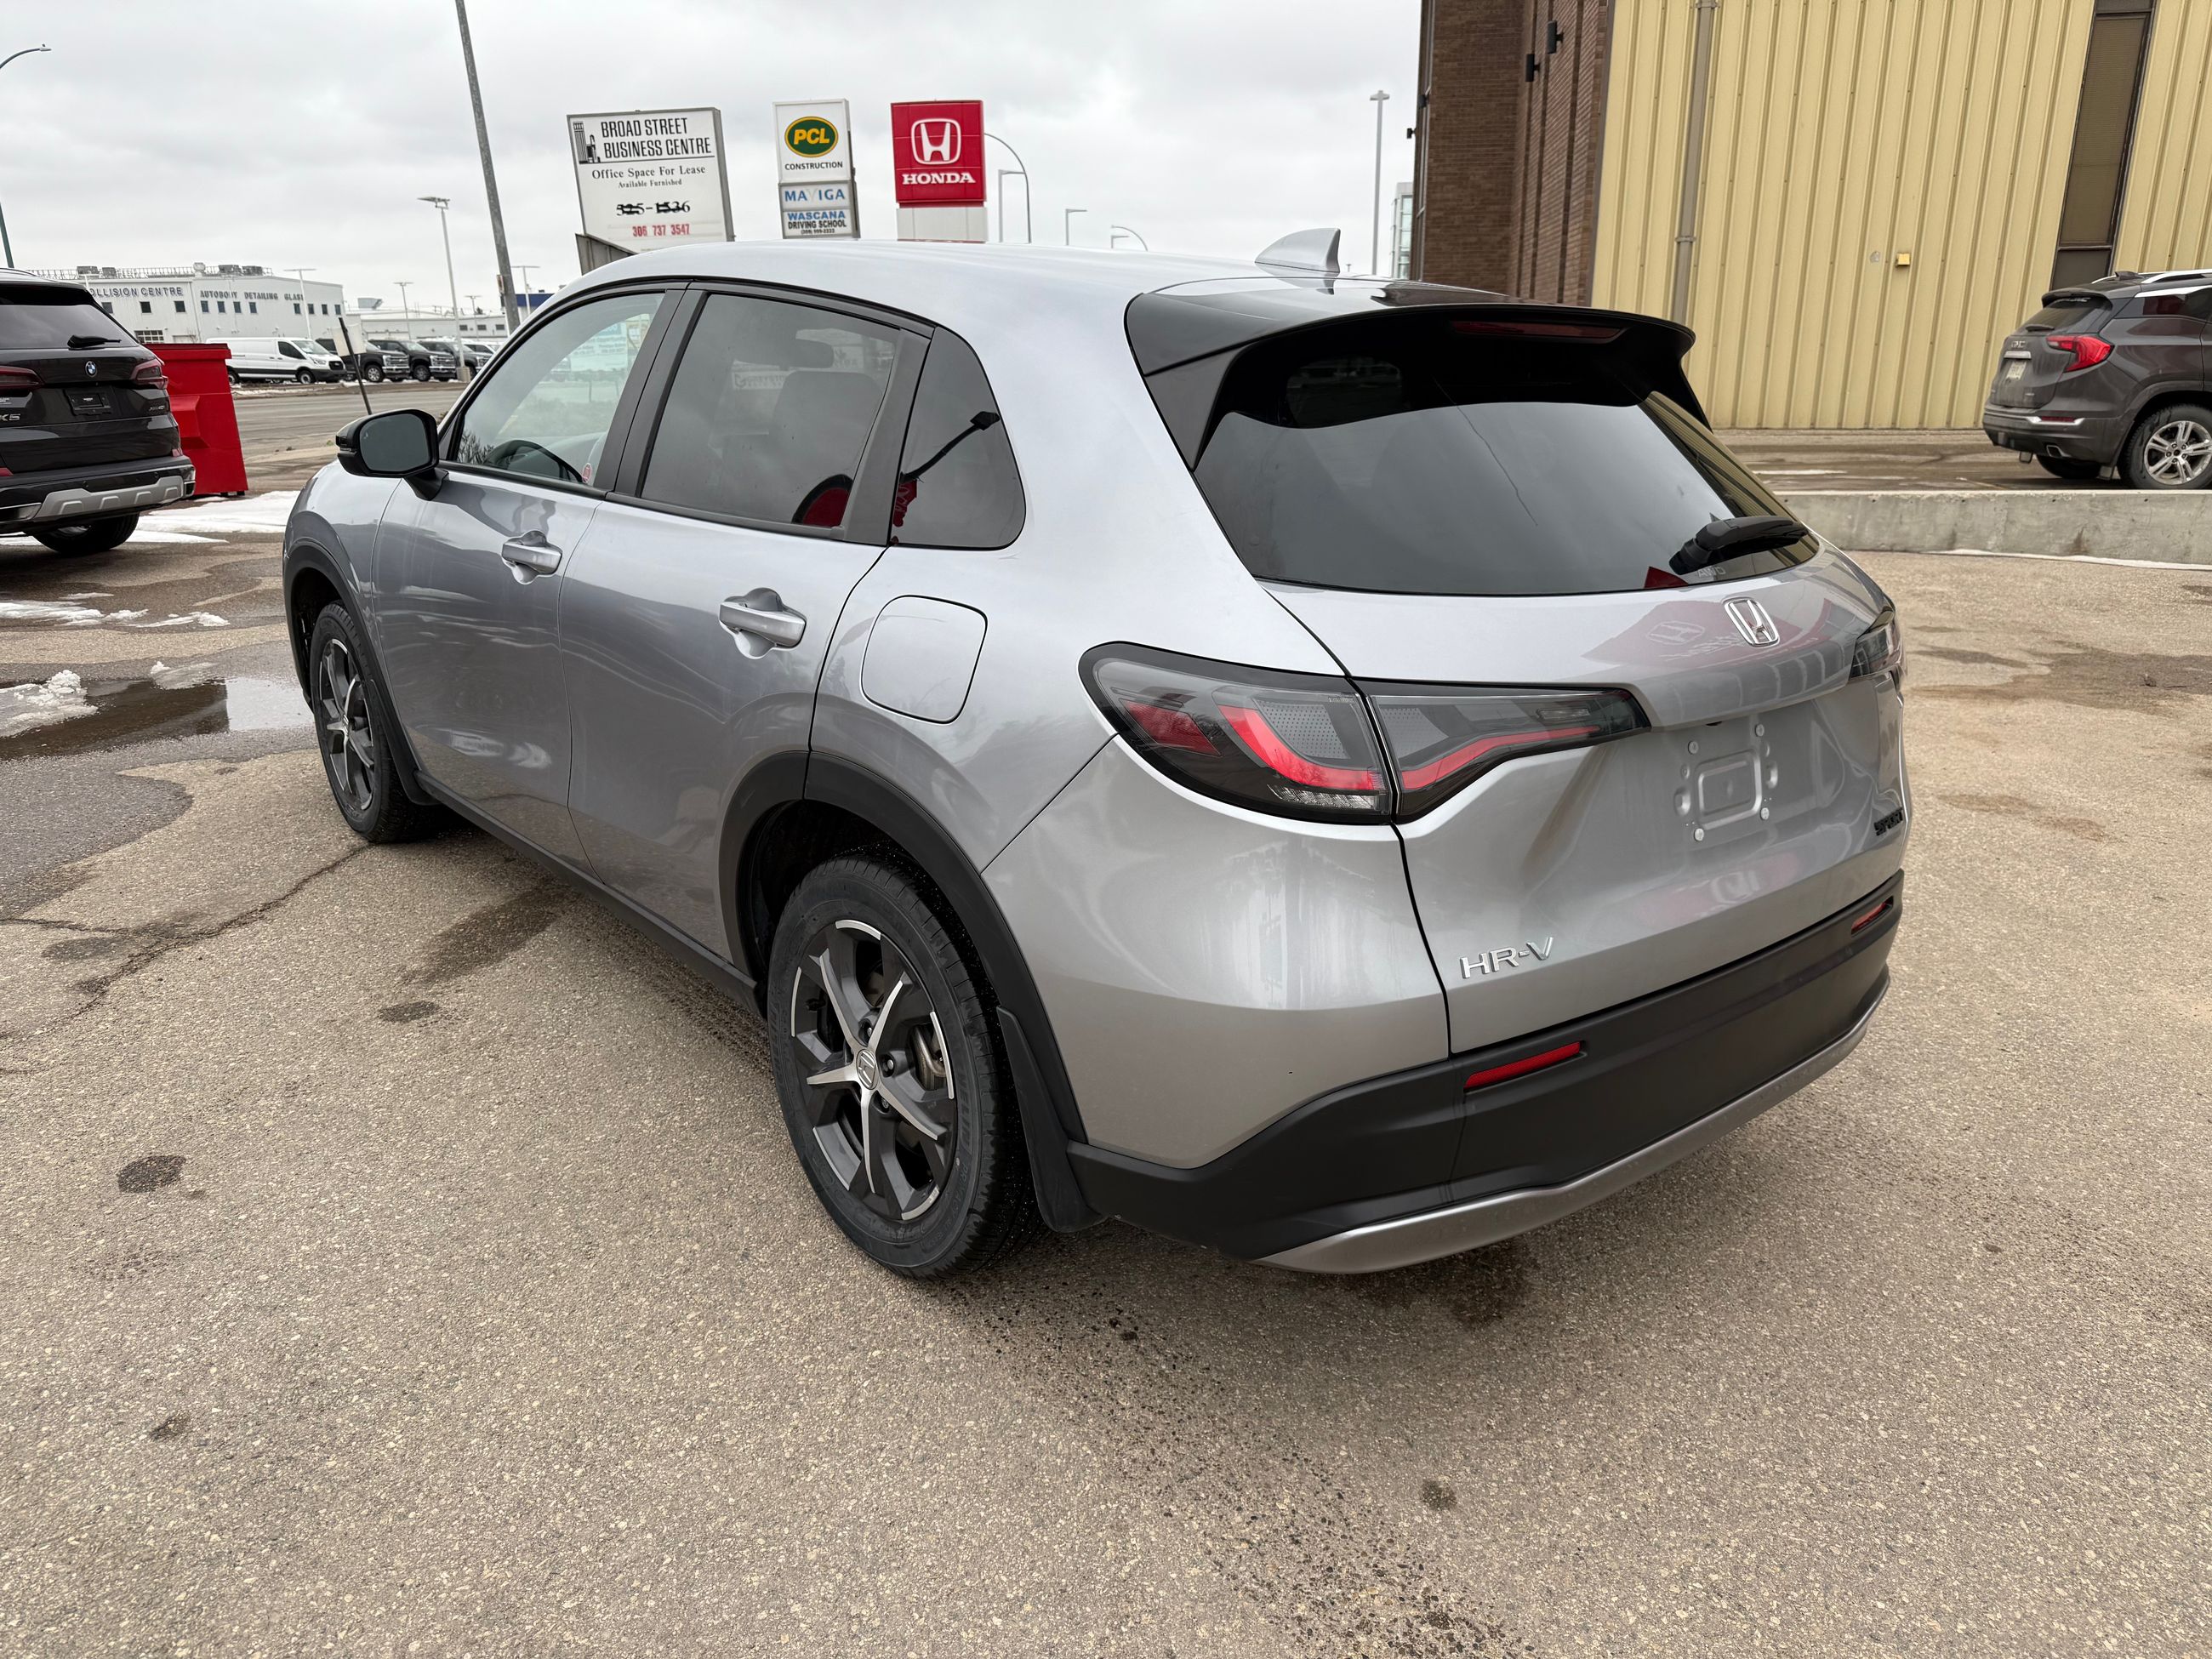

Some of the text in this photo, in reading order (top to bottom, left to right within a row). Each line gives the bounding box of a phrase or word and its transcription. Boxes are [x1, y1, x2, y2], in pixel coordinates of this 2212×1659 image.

[601, 117, 687, 138] BROAD STREET
[793, 128, 830, 145] PCL
[603, 137, 712, 158] BUSINESS CENTRE
[784, 162, 843, 170] CONSTRUCTION
[592, 165, 706, 180] Office Space For Lease
[902, 172, 977, 185] HONDA
[618, 179, 682, 189] Available Furnished
[787, 210, 846, 221] WASCANA
[632, 223, 691, 237] 306 737 3547
[788, 219, 847, 229] DRIVING SCHOOL
[89, 287, 184, 297] OLLISION CENTRE
[243, 292, 279, 300] DETAILING
[1696, 565, 1726, 577] AWD
[1459, 937, 1554, 979] HR-V
